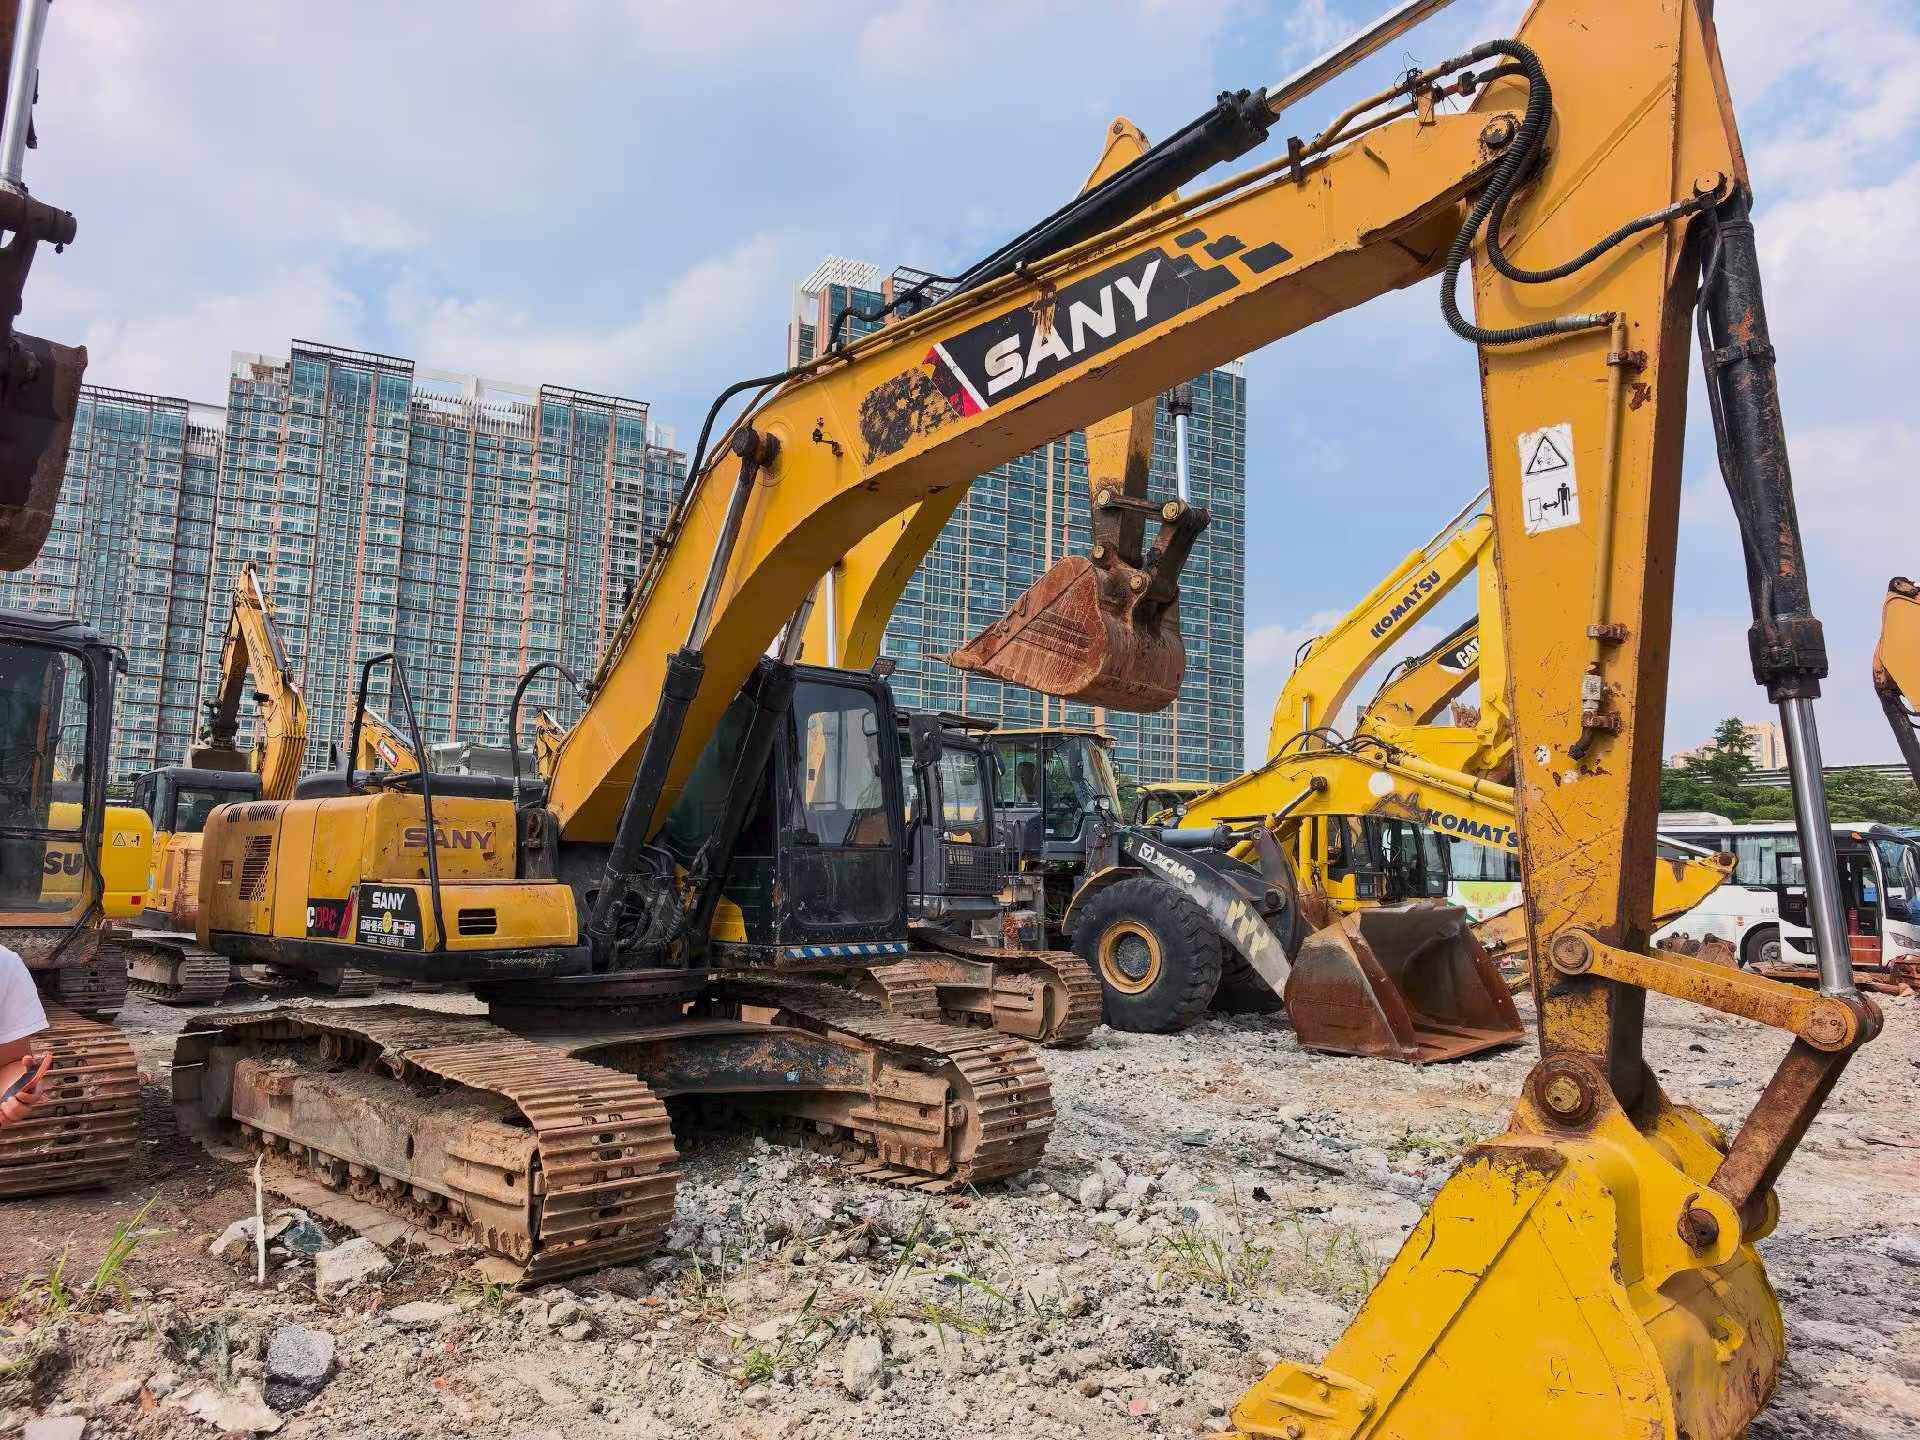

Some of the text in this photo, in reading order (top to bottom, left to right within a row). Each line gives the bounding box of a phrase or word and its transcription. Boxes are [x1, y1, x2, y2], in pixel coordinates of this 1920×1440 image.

[983, 258, 1162, 396] SANY
[1370, 570, 1441, 639] KOMATSU
[403, 827, 493, 849] SANY
[1424, 808, 1520, 848] KOMATS
[43, 851, 83, 876] SU
[371, 891, 406, 911] SANY
